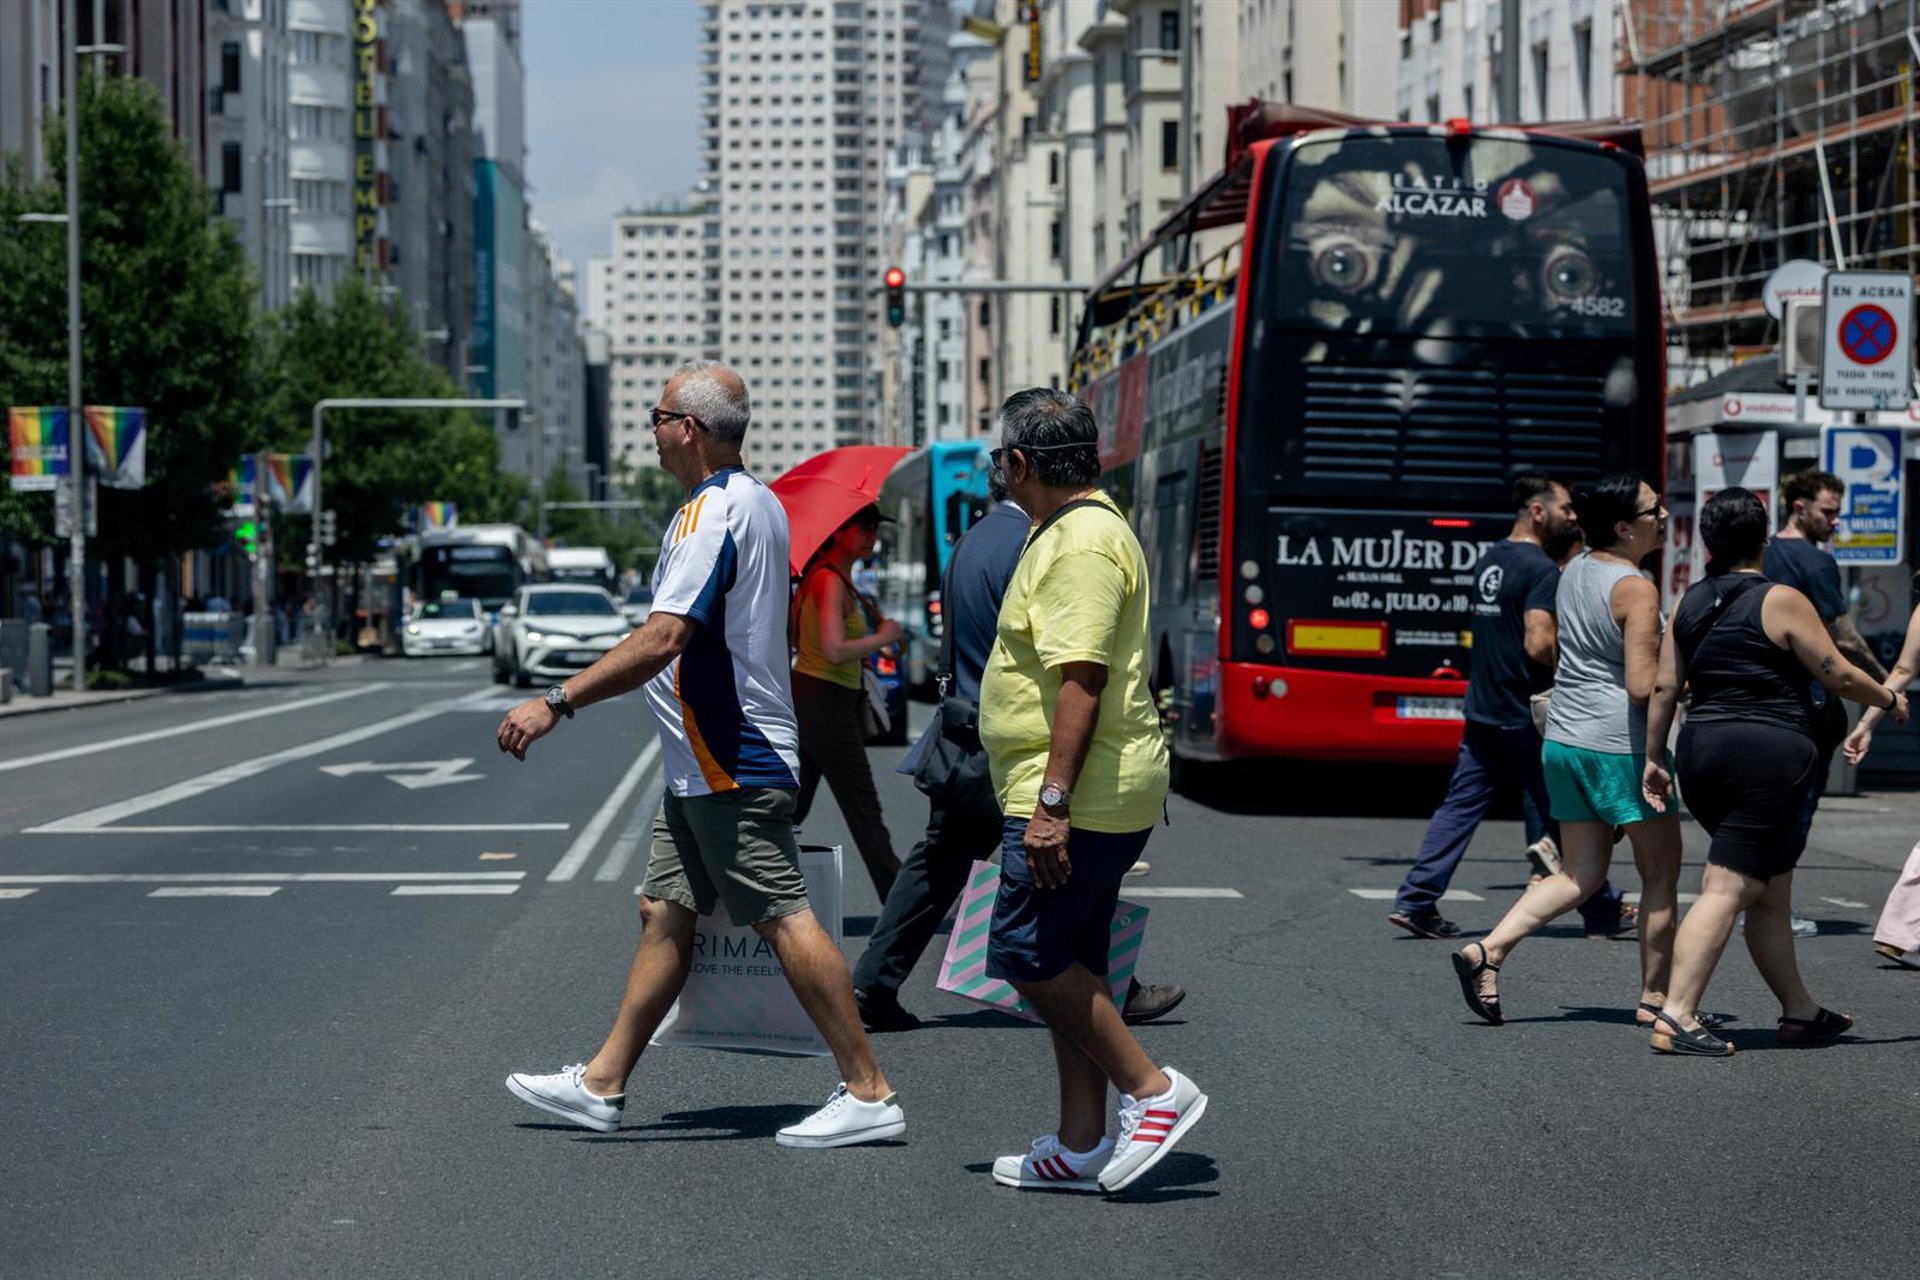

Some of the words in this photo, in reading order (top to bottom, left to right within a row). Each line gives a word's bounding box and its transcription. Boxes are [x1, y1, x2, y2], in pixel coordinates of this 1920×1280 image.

[1832, 287, 1851, 297] EN
[1860, 287, 1905, 297] ACERA
[1570, 296, 1625, 317] 4582
[1277, 535, 1323, 566] LA
[1331, 529, 1444, 570] MUJER
[1385, 592, 1440, 613] JULIO
[693, 933, 772, 958] RIMA
[690, 963, 718, 974] LOVE
[721, 965, 742, 975] THE
[747, 965, 786, 976] FEELIN
